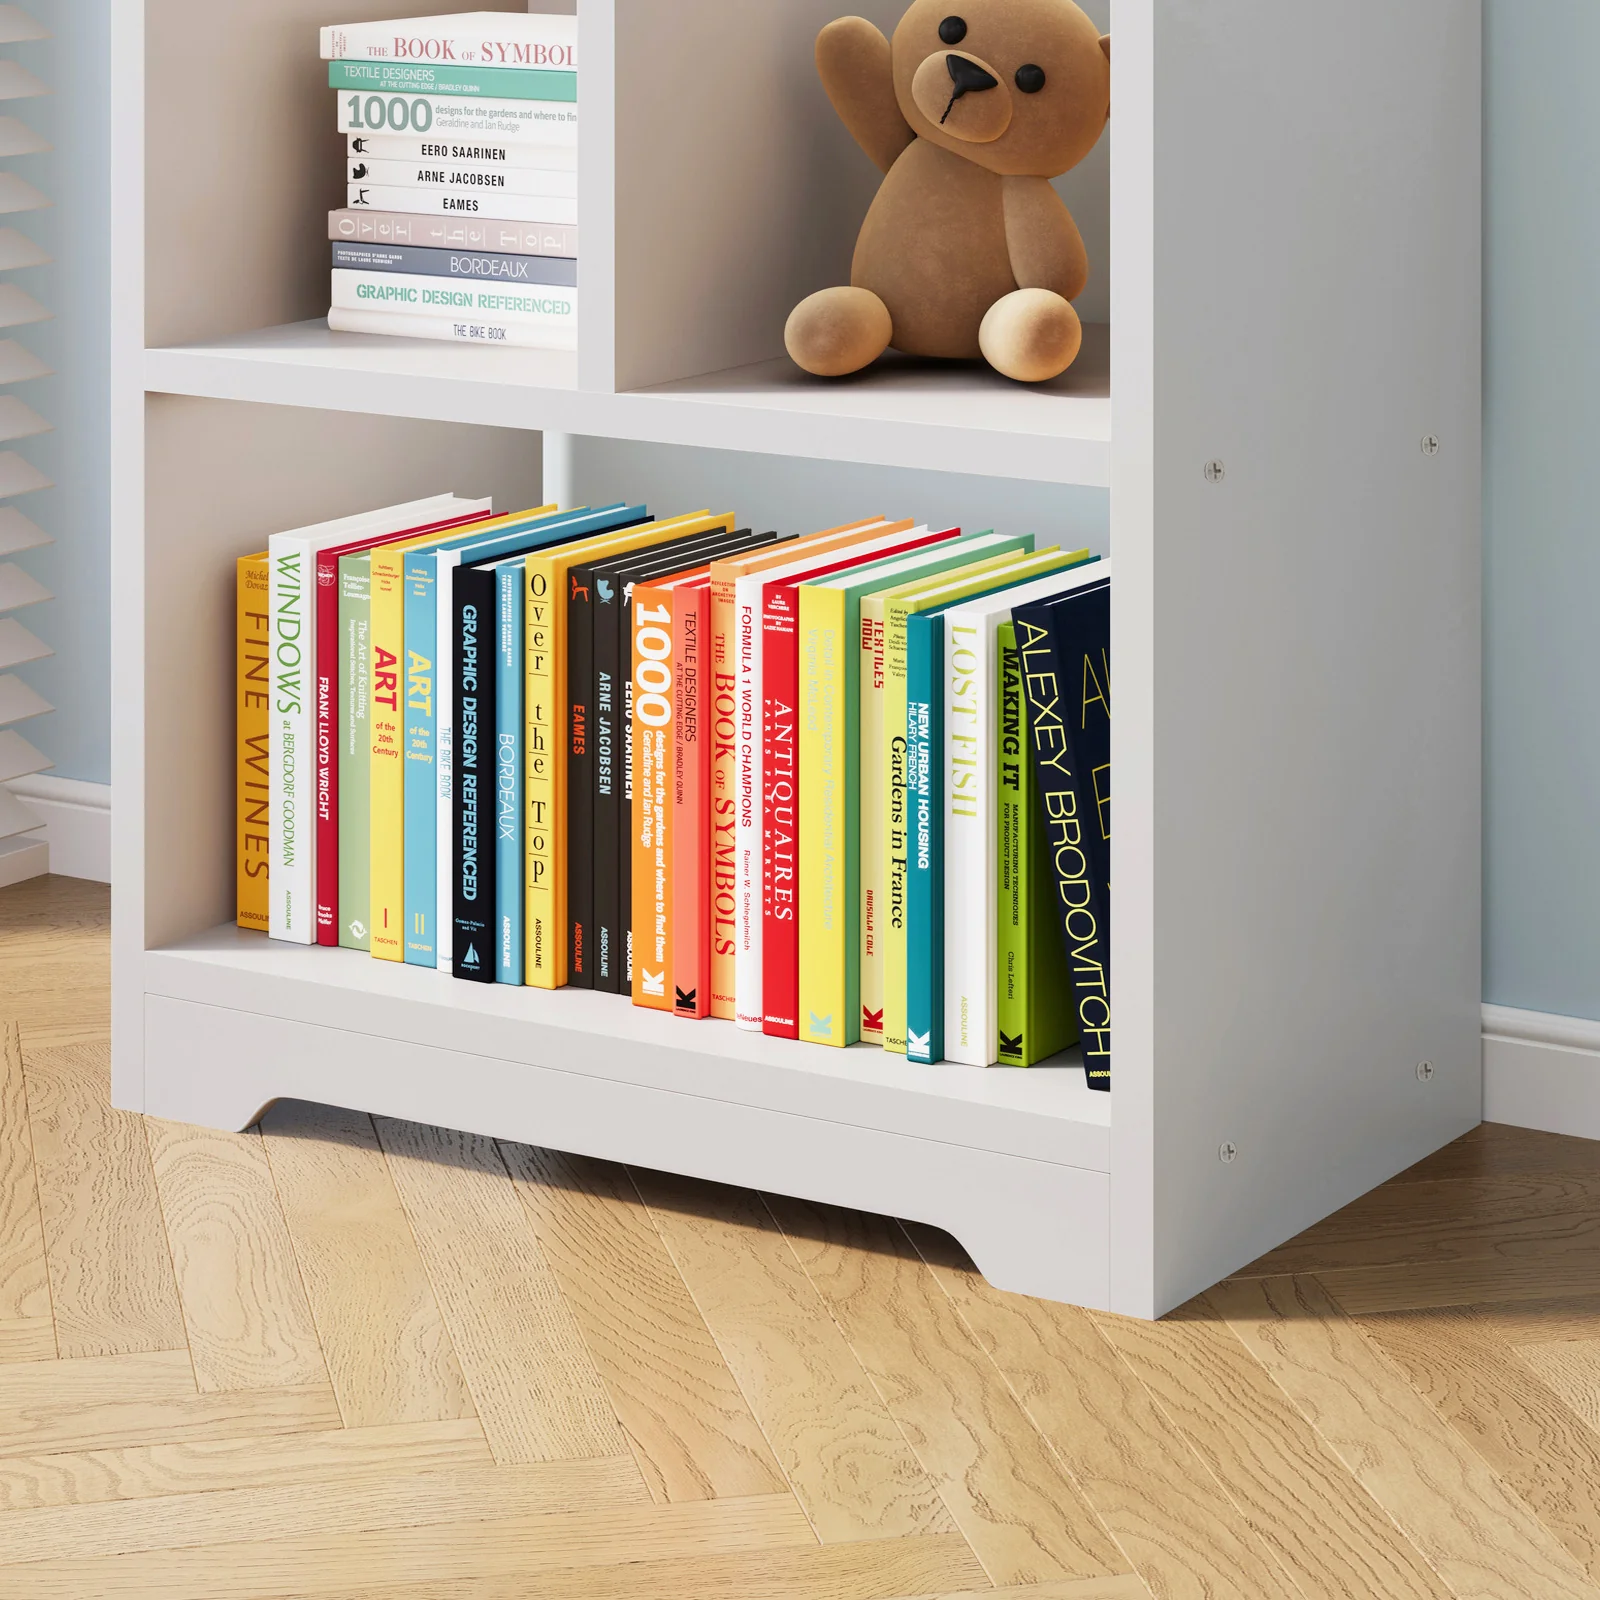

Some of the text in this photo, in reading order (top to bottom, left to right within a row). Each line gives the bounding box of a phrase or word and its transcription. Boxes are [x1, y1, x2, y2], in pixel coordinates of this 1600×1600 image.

[344, 65, 435, 81] TEXTILE DESIGNERS
[366, 37, 577, 67] THE BOOK OF SYMBOL
[347, 94, 433, 133] 1000
[435, 105, 463, 117] designs
[463, 106, 475, 117] for
[475, 107, 487, 117] the
[488, 108, 518, 120] gardens
[518, 110, 533, 120] and
[533, 111, 557, 121] where
[557, 112, 566, 122] to
[435, 117, 520, 134] Geraldine and Ian Rudge
[417, 170, 505, 187] ARNE JACOBSEN
[421, 144, 506, 161] EERO SAARINEN
[338, 218, 562, 249] Over the Top
[443, 198, 479, 212] EAMES
[356, 284, 572, 315] GRAPHIC DESIGN REFERENCED
[450, 256, 529, 278] BORDEAUX
[453, 324, 507, 340] THE BIKE BOOK
[356, 620, 368, 719] The Art of Knitting
[636, 603, 672, 727] 1000
[742, 605, 752, 673] FORMULA
[873, 620, 884, 689] TEXTILES
[277, 551, 301, 867] WINDOWS at BERGDORF GOODMAN
[374, 646, 397, 712] ART
[407, 649, 432, 717] ART
[685, 611, 697, 743] TEXTILE DESIGNERS
[245, 611, 269, 880] FINE WINES
[319, 676, 330, 821] FRANK LLOYD WRIGHT
[375, 722, 396, 732] of the
[378, 734, 394, 743] 20th
[409, 727, 430, 737] of the
[411, 738, 428, 749] 20th
[530, 573, 547, 883] Over the Top
[573, 704, 586, 755] EAMES
[599, 671, 612, 795] ARNE JACOBSEN
[676, 662, 684, 805] AT THE CUTTING EDGE BRADLEY QUINN
[742, 690, 752, 740] WORLD
[908, 702, 918, 791] HILARY FRENCH
[952, 625, 978, 817] LOST FISH
[1003, 646, 1020, 791] MAKING IT
[372, 745, 399, 759] Century
[406, 750, 433, 764] Century
[440, 727, 452, 800] THE BIKE BOOK
[462, 604, 478, 901] GRAPHIC DESIGN REFERENCED
[742, 744, 752, 828] CHAMPIONS
[918, 702, 929, 870] NEW URBAN HOUSING
[499, 733, 515, 842] BORDEAUX
[641, 730, 654, 849] Geraldine and Ian Rudge
[715, 633, 736, 956] THE BOOK OF SYMBOLS
[764, 699, 772, 917] PARIS FLEA MARKETS
[770, 698, 793, 921] ANTIQUAIRES
[654, 730, 666, 963] designs for the gardens and where to find them
[892, 736, 908, 929] Gardens in France
[1017, 620, 1072, 777] ALEXEY
[1045, 791, 1111, 1056] BRODOVITCH
[742, 849, 751, 951] Rainer W. Schlegelmilch
[373, 936, 398, 946] TASCHEN
[503, 915, 511, 968] ASSOULINE
[574, 921, 583, 973] ASSOULINE
[600, 926, 609, 978] ASSOULINE
[866, 934, 874, 957] COLE
[1007, 951, 1015, 972] Chris
